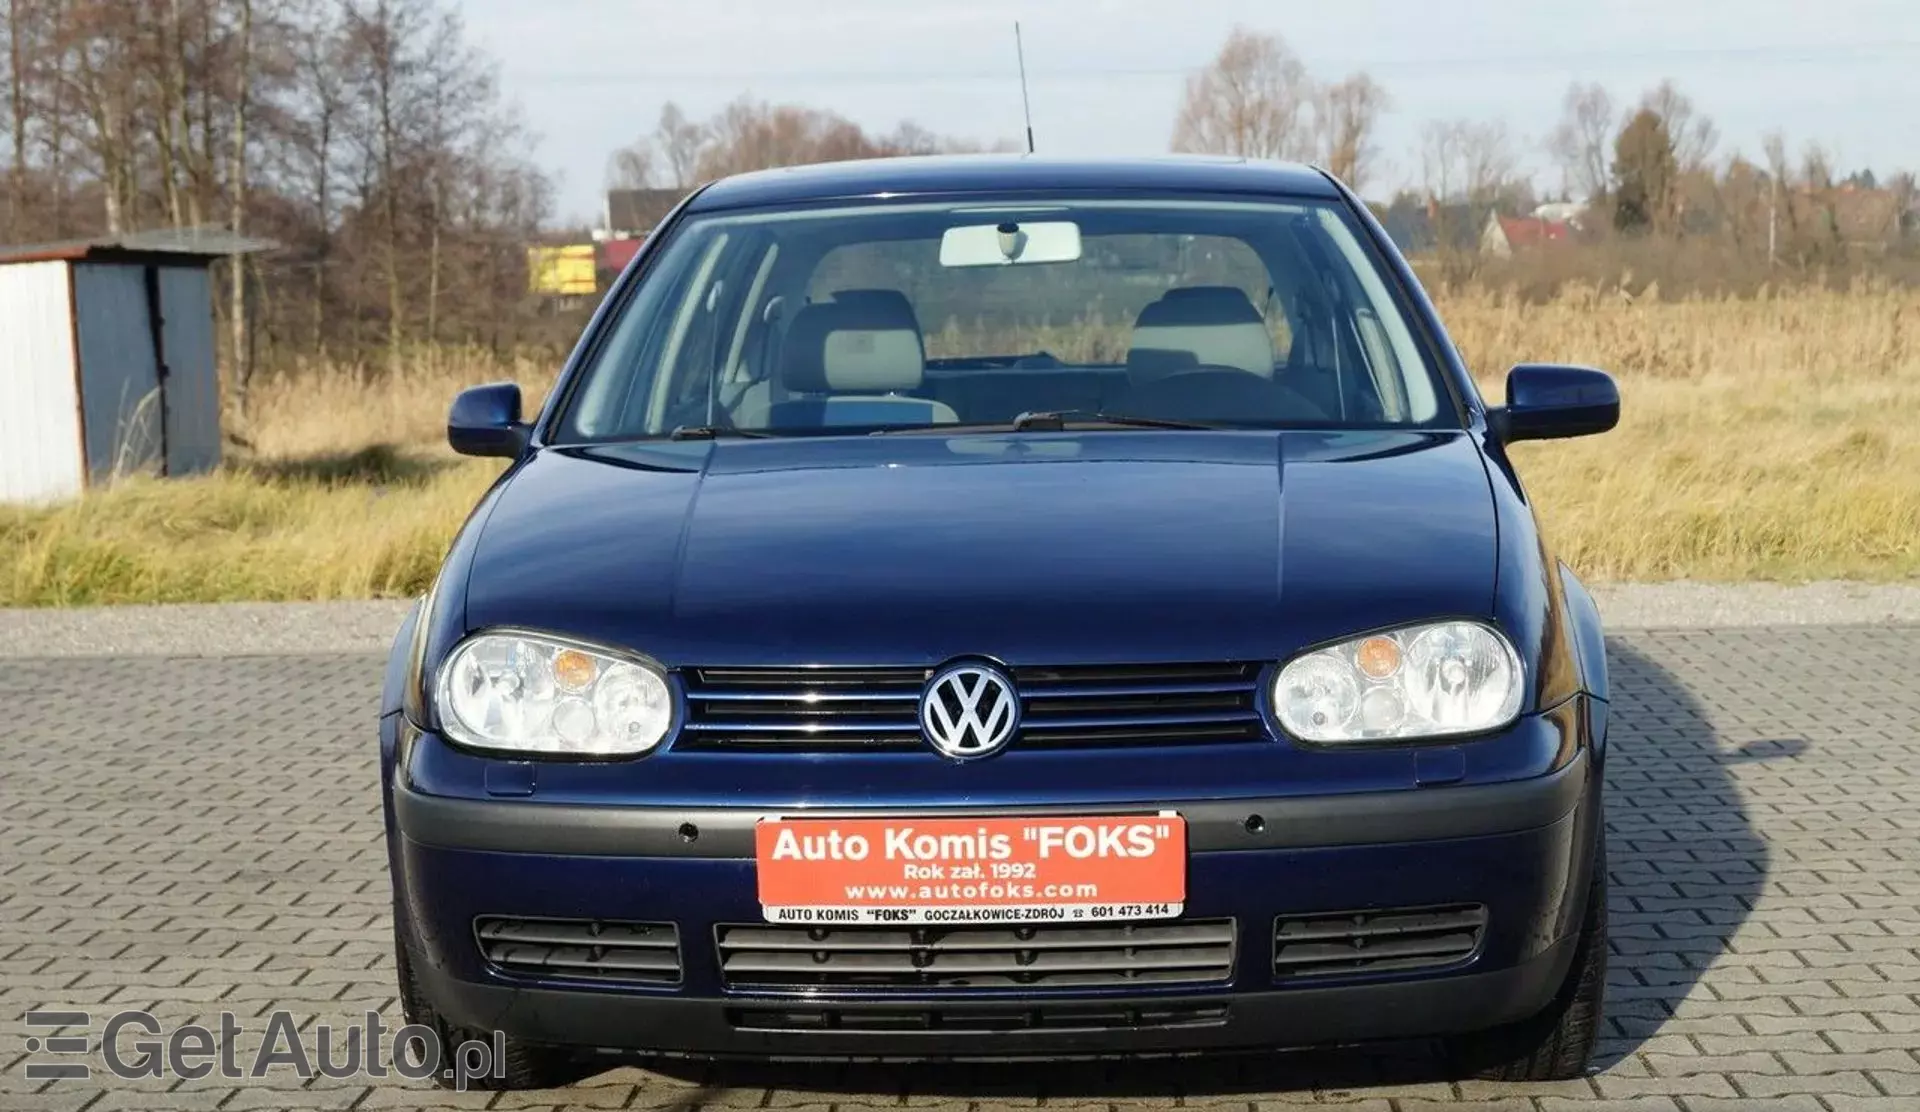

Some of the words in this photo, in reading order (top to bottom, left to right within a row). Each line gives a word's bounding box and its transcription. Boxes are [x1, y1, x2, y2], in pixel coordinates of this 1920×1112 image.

[772, 828, 869, 860] Auto
[885, 828, 1012, 860] Komis
[1023, 825, 1169, 859] "FOKS"
[904, 864, 944, 879] Rok
[950, 863, 985, 879] zał.
[991, 863, 1036, 879] 1992
[845, 882, 1097, 899] www.autofoks.com
[779, 909, 812, 921] AUTO
[817, 909, 859, 921] KOMIS
[924, 907, 1065, 921] GOCZAŁKOWICE-ZDRÓJ
[1091, 906, 1114, 918] 601
[1119, 905, 1141, 916] 473
[1146, 904, 1168, 915] 414
